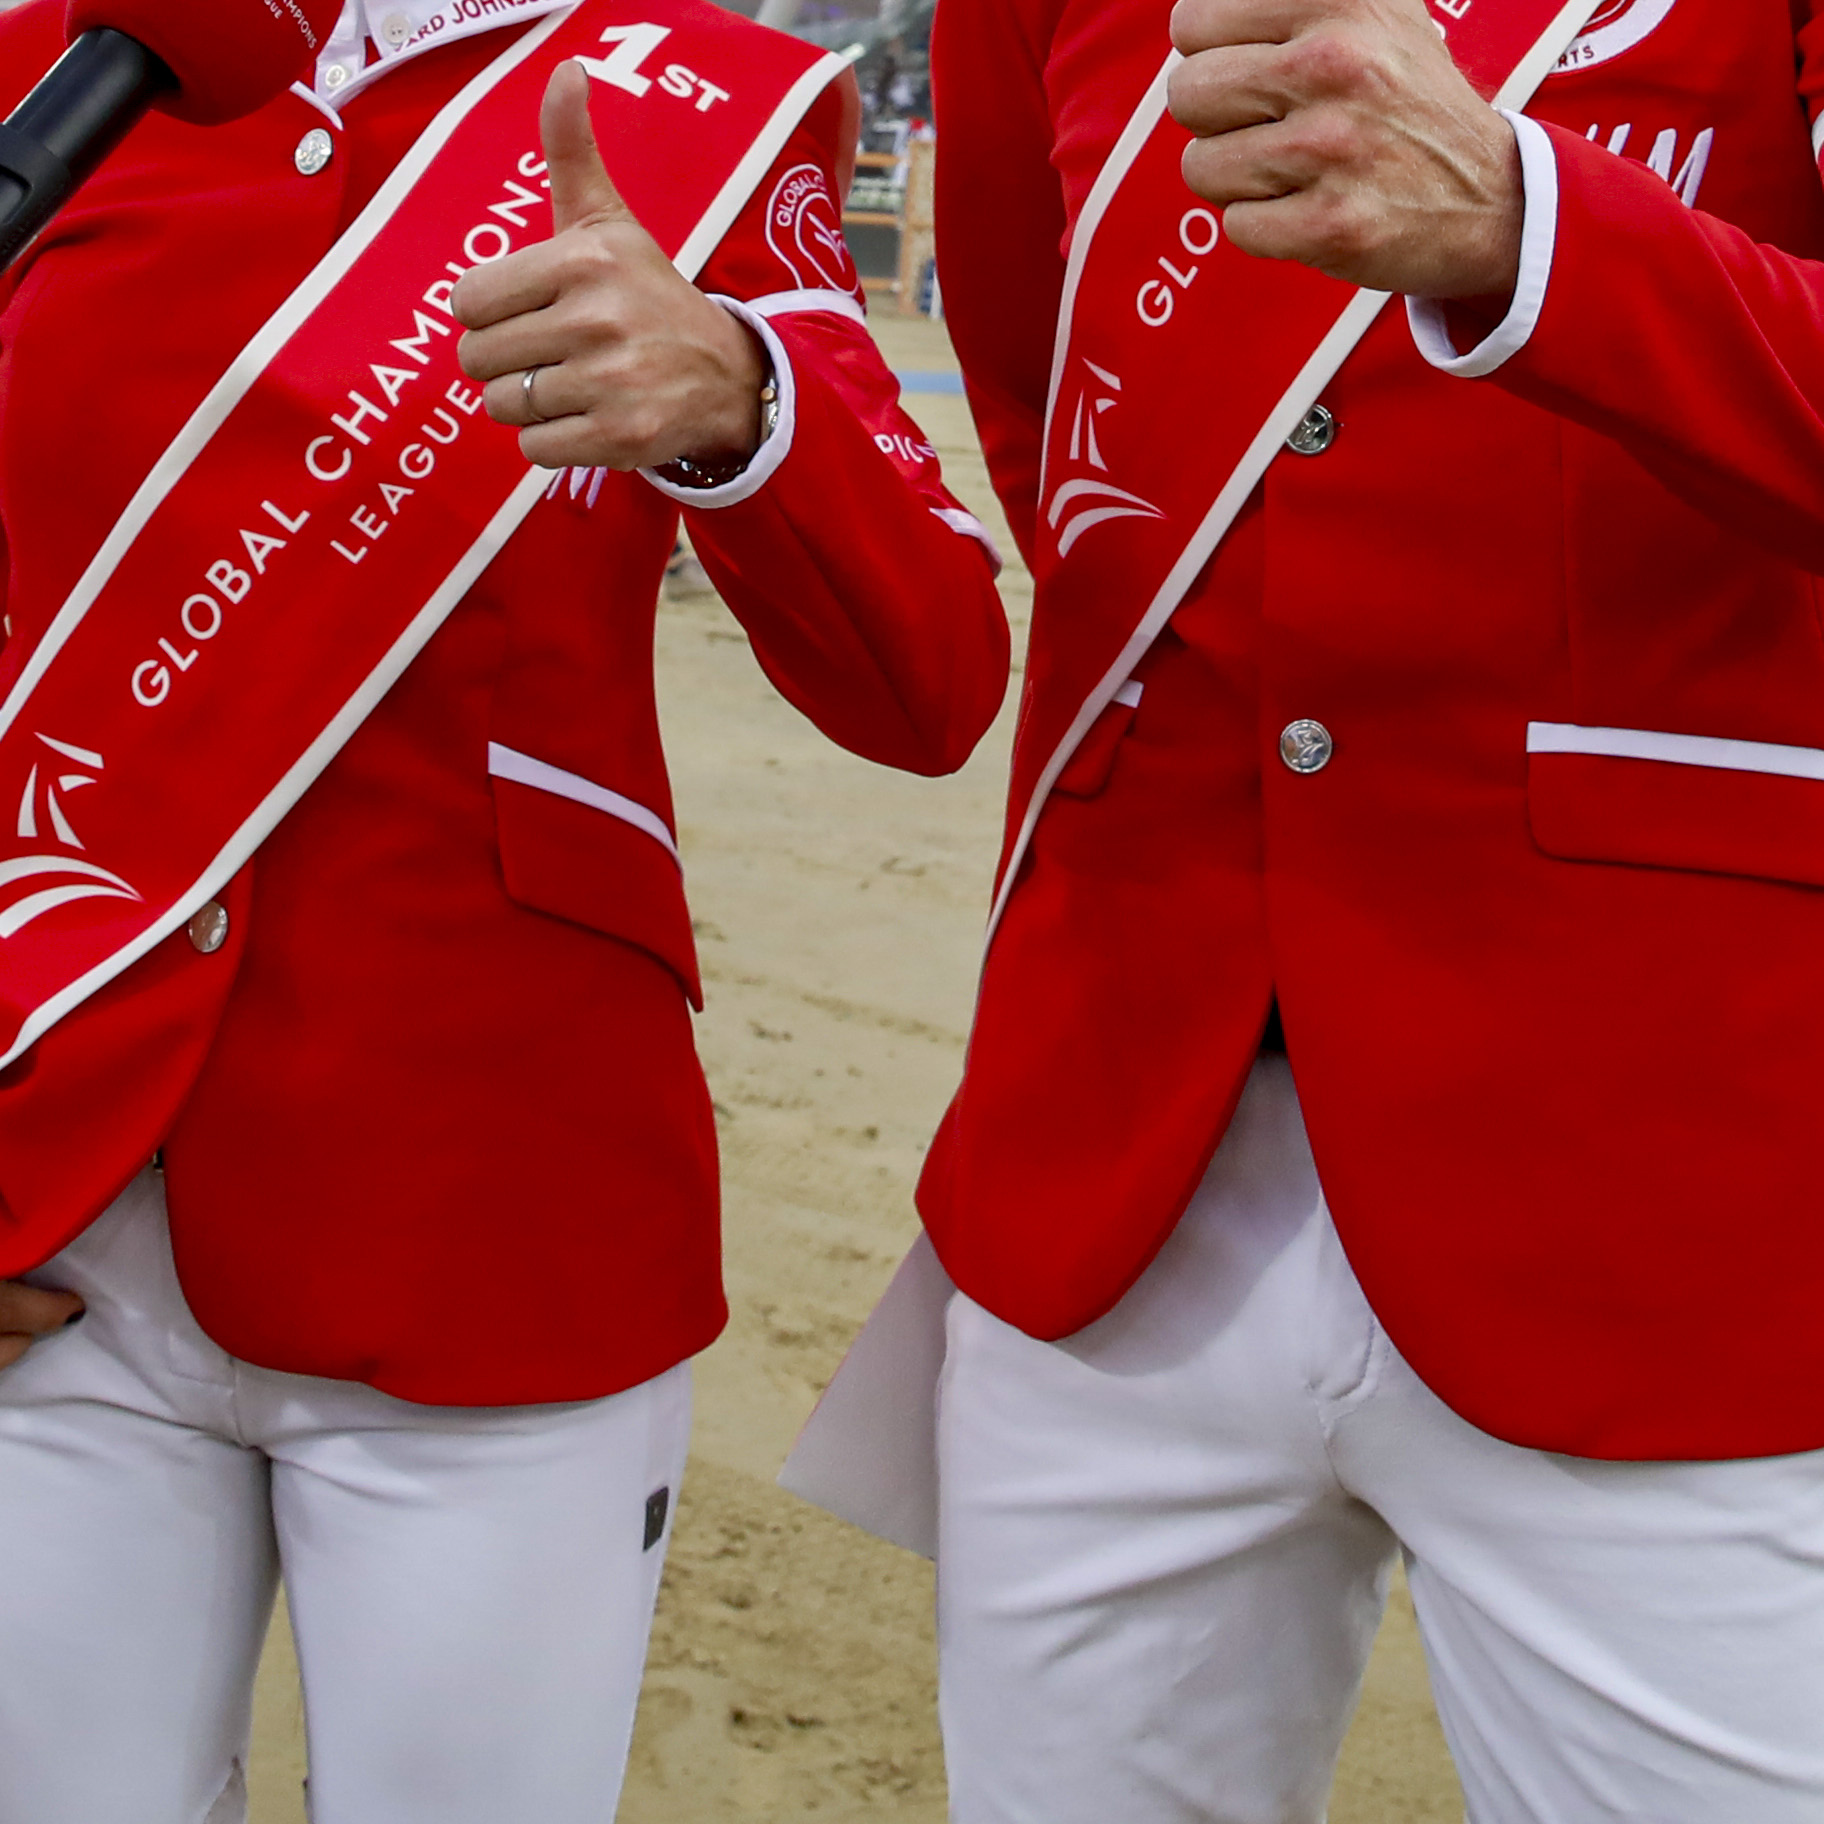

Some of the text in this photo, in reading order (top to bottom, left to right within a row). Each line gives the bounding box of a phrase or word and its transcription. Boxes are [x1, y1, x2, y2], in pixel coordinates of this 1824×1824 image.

[395, 14, 446, 52] ARD
[1557, 46, 1595, 68] RTS
[1136, 207, 1219, 327] GLO
[330, 379, 482, 564] LEAGUE
[132, 499, 310, 707] GLOBAL
